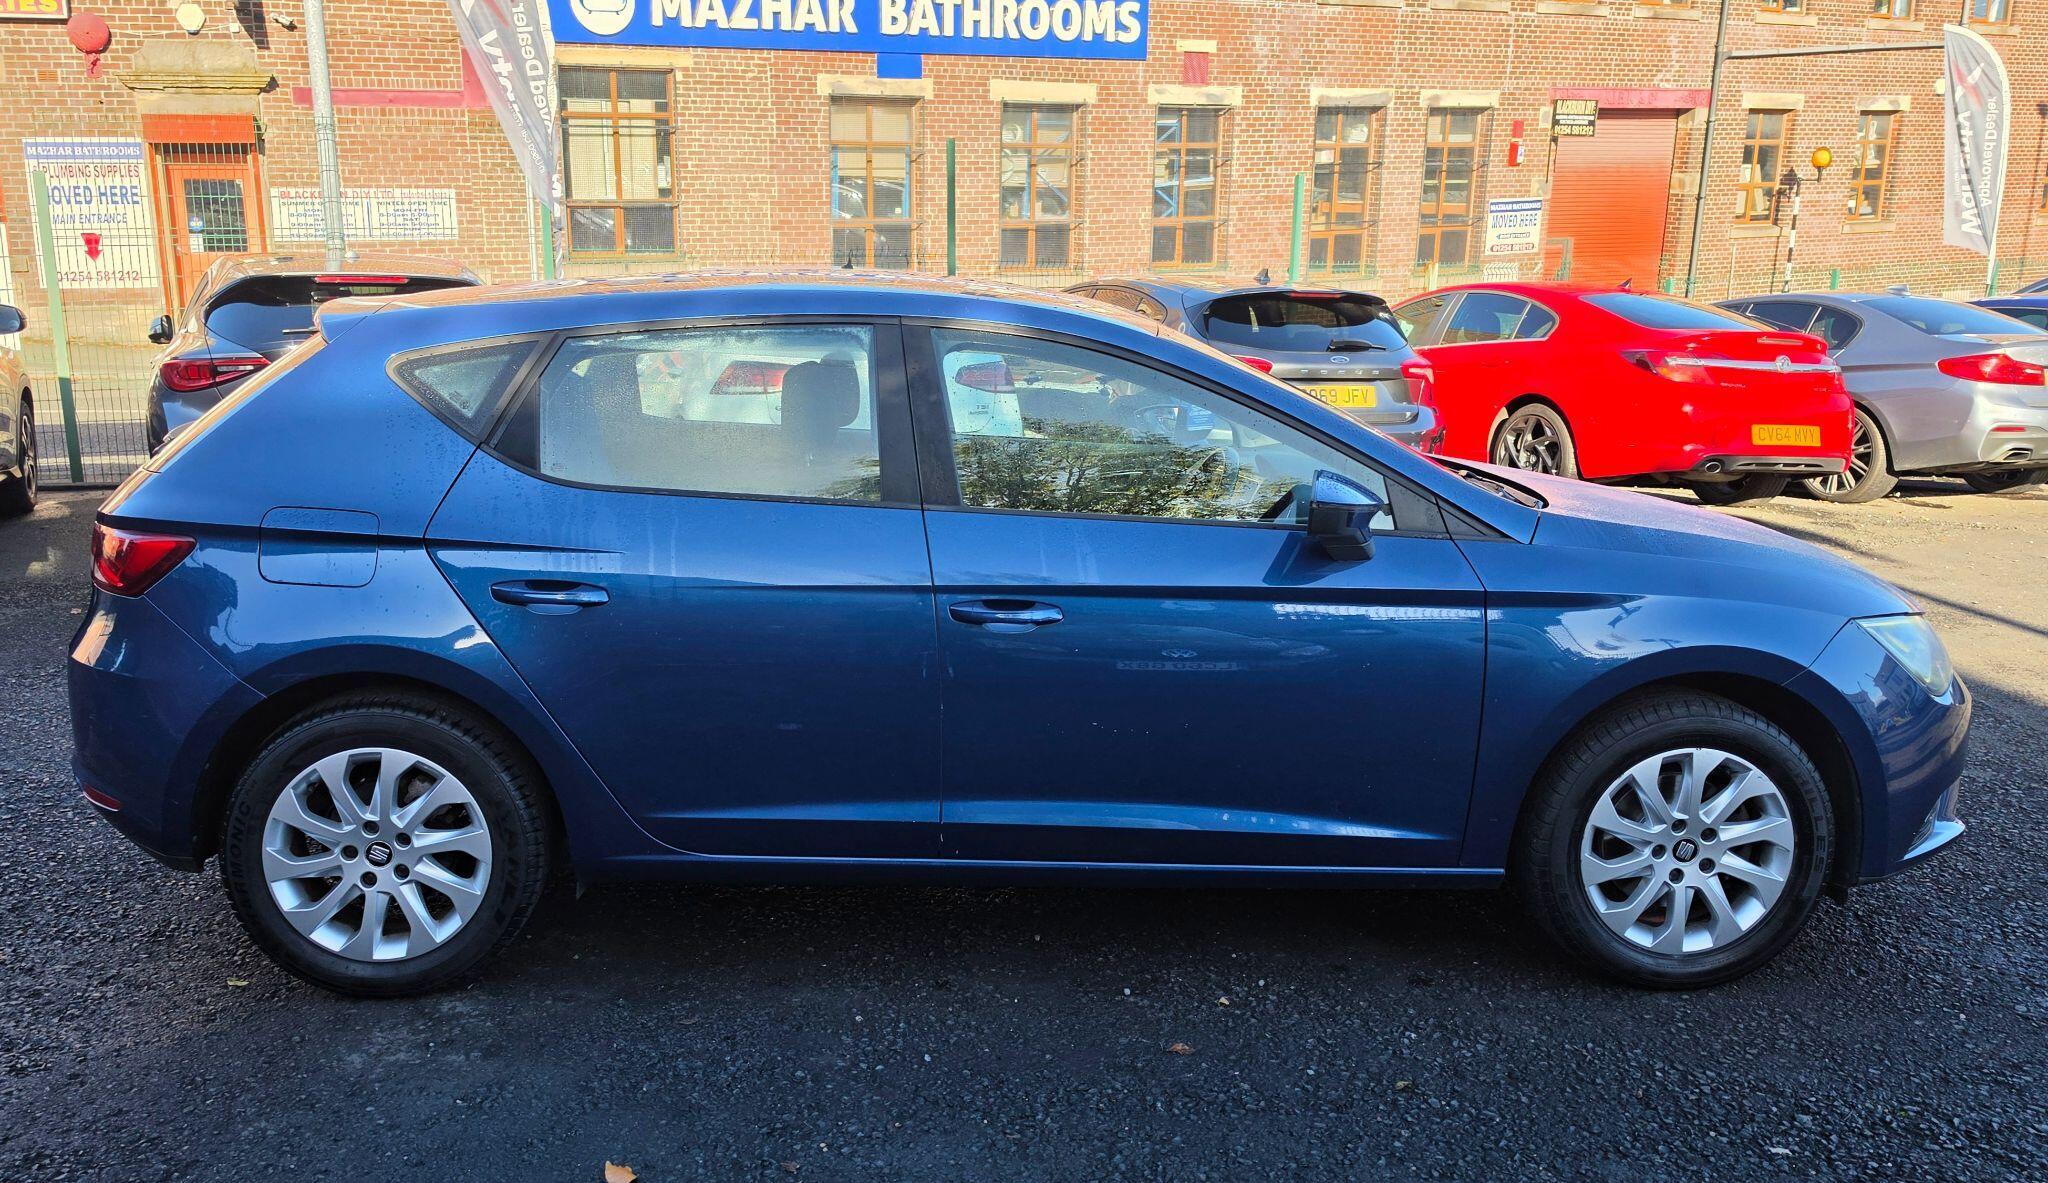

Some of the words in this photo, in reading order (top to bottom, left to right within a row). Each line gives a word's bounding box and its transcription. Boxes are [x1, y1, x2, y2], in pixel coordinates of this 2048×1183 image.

[0, 0, 58, 12] IES
[651, 0, 858, 33] MAZHAR
[879, 0, 1141, 42] BATHROOMS
[27, 146, 72, 155] MAZHAR
[74, 146, 140, 155] BATHROOMS
[94, 164, 140, 178] SUPPLIES
[97, 185, 140, 205] HERE
[52, 213, 76, 224] MAIN
[80, 212, 128, 224] ENTRANCE
[1492, 214, 1518, 228] MOVED
[1519, 213, 1537, 227] HERE
[97, 270, 141, 281] 581212
[1342, 388, 1369, 404] JFV
[1758, 427, 1791, 441] CV64
[1794, 428, 1815, 442] MVY
